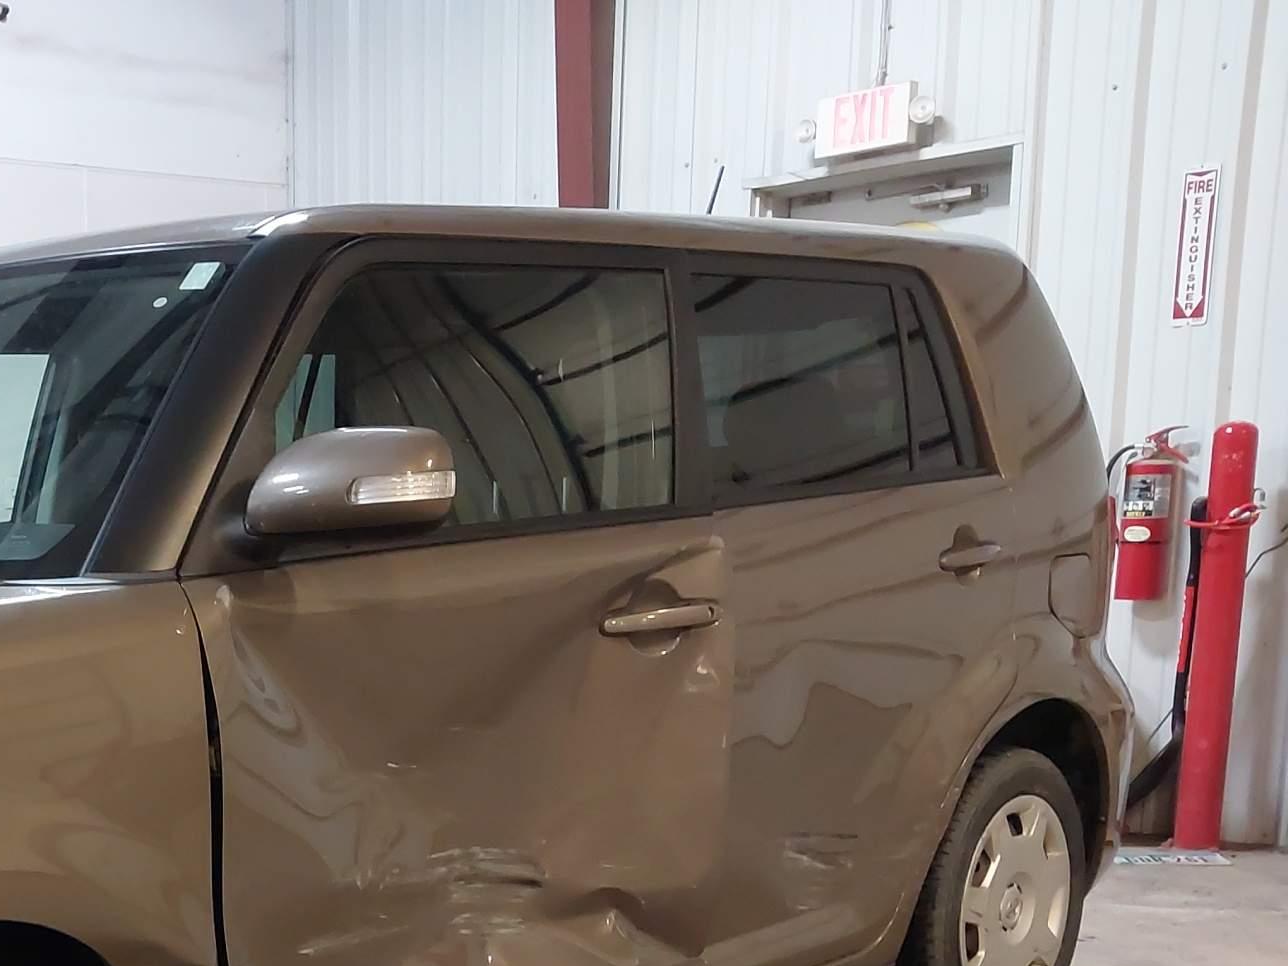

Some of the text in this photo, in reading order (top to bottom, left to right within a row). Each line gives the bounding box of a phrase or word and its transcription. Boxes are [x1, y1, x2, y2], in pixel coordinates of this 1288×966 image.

[833, 86, 895, 149] EXIT
[1186, 178, 1214, 195] FIRE
[1184, 196, 1204, 311] EXTINGUISHER
